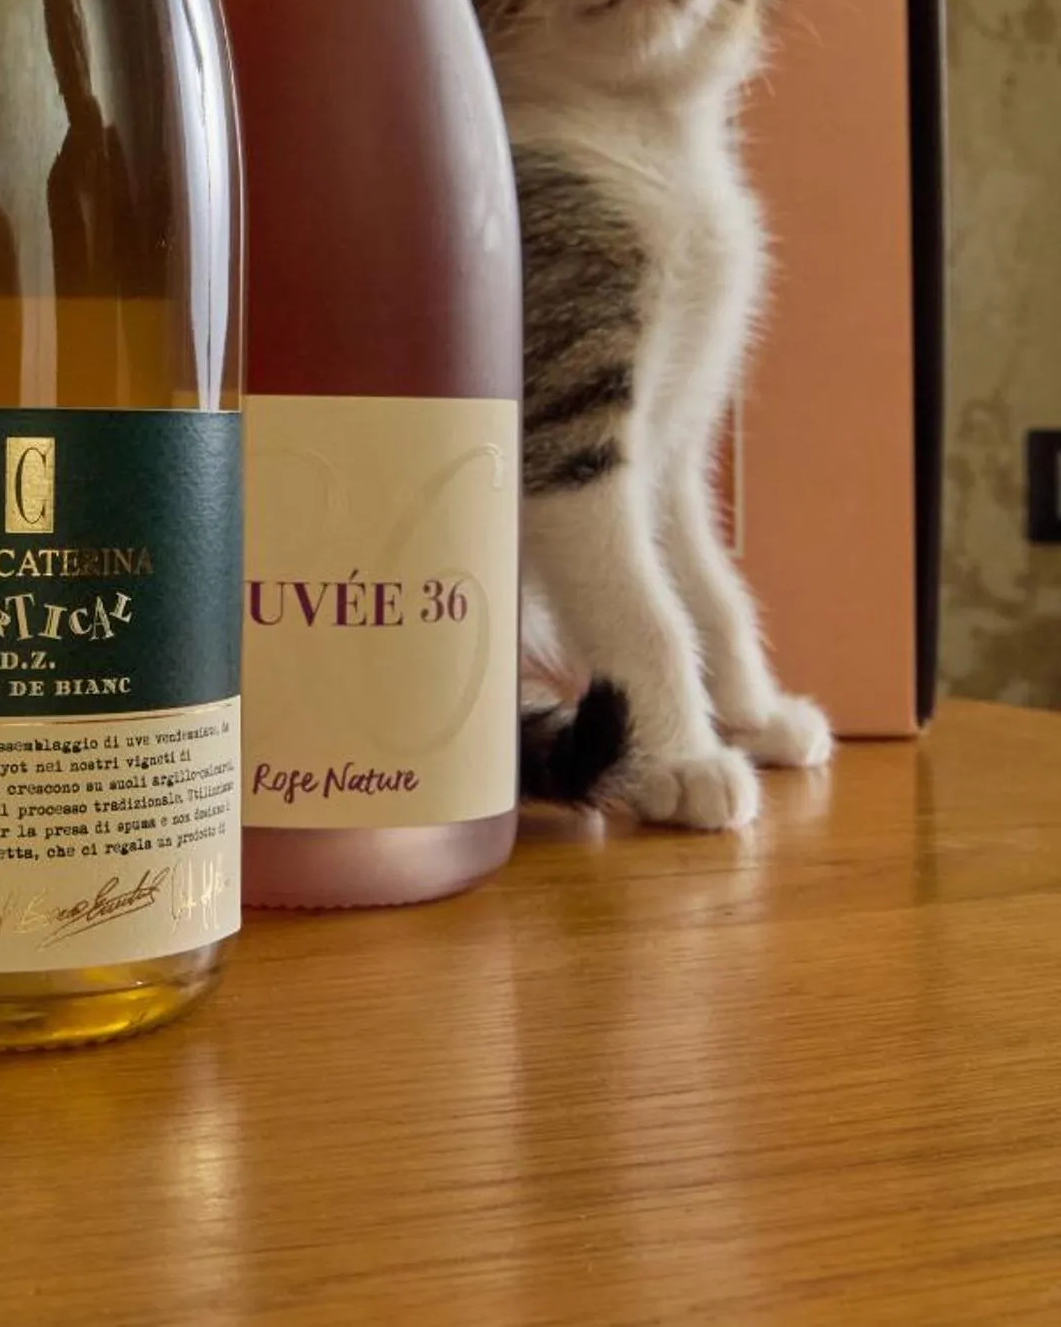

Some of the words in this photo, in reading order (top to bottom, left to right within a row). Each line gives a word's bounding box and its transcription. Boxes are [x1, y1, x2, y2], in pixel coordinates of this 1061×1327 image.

[15, 447, 47, 524] C
[244, 569, 404, 627] UVÉE
[420, 578, 468, 624] 36
[9, 680, 44, 696] DE
[104, 735, 120, 748] di
[126, 735, 150, 747] uve
[36, 760, 62, 773] nei
[70, 756, 119, 772] nostri
[126, 751, 176, 770] vigneti
[7, 781, 80, 796] crescono
[86, 781, 103, 793] su
[109, 775, 147, 790] suoli
[323, 762, 419, 800] Nature
[18, 804, 88, 820] processo
[17, 823, 36, 838] la
[44, 824, 89, 839] presa
[95, 820, 111, 834] di
[117, 818, 156, 834] spuma
[47, 845, 75, 858] che
[81, 843, 98, 857] ci
[104, 839, 152, 856] regala
[157, 837, 172, 849] un
